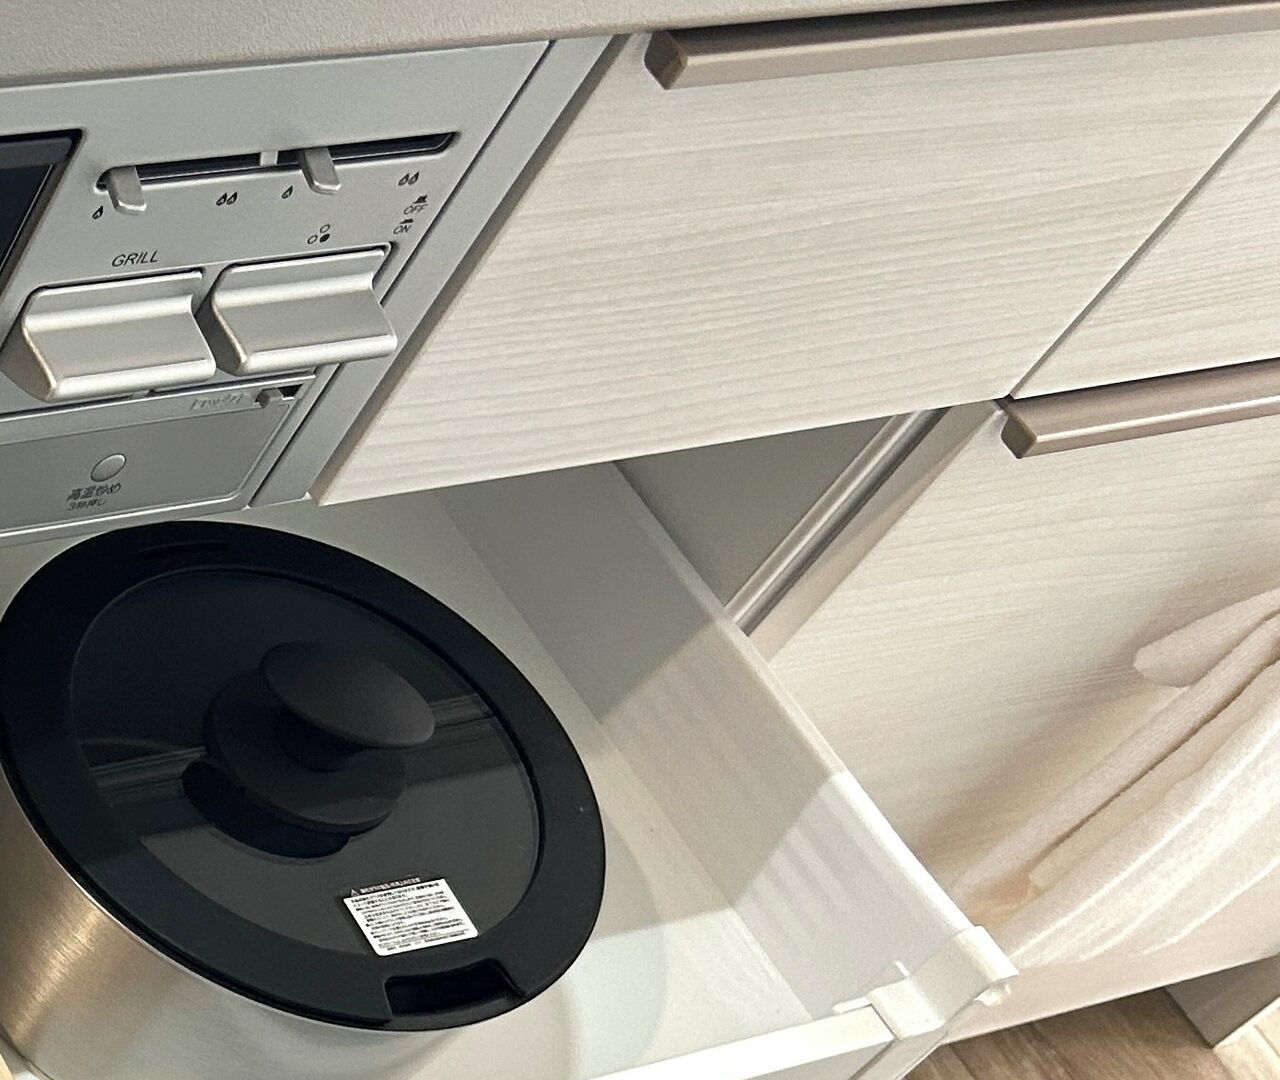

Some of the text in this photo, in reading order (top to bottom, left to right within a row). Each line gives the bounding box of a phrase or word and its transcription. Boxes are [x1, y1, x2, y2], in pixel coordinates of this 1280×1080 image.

[403, 203, 428, 215] OFF
[393, 224, 412, 234] ON
[111, 250, 158, 267] GRILL
